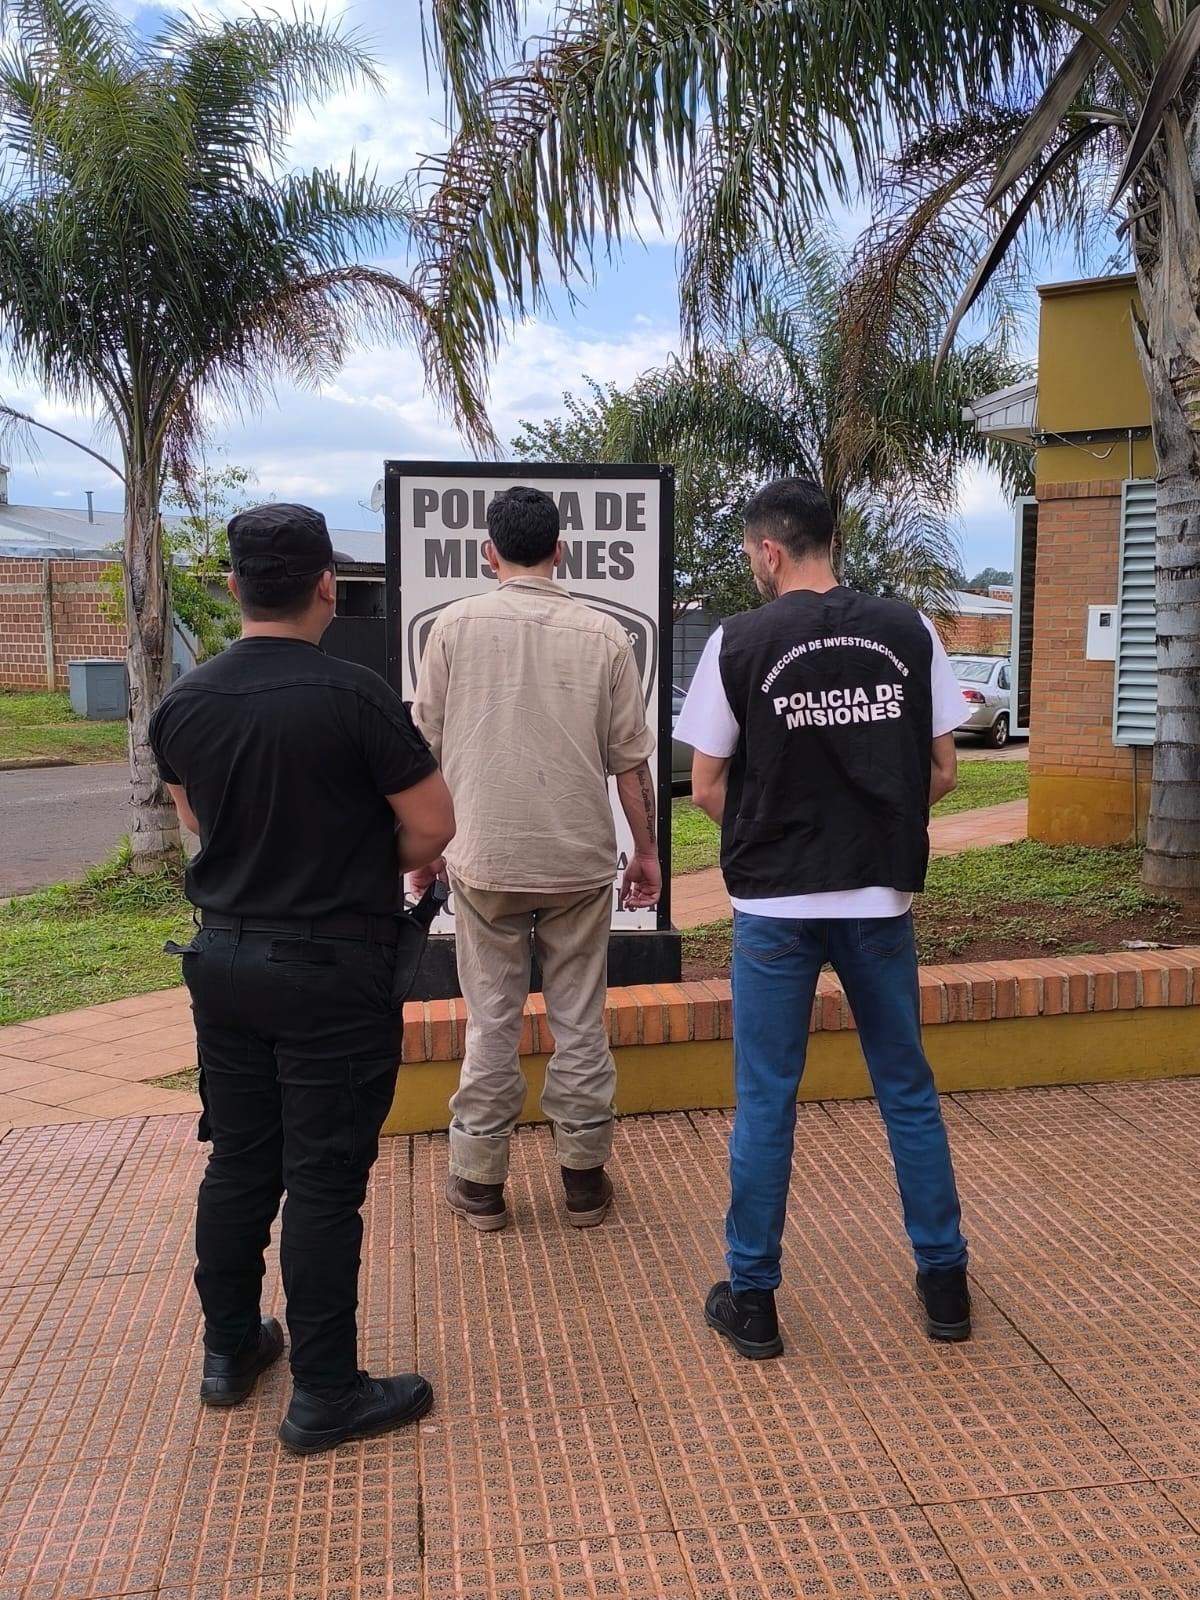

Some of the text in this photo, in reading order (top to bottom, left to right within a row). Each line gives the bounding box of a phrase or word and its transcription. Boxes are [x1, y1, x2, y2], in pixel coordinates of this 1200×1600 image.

[412, 487, 647, 532] POLA DE
[424, 539, 636, 581] MINES
[761, 636, 909, 694] DIRECCIÓN DE INVESTIGACIONES
[773, 684, 905, 715] POLICIA DE
[785, 701, 902, 730] MISIONES
